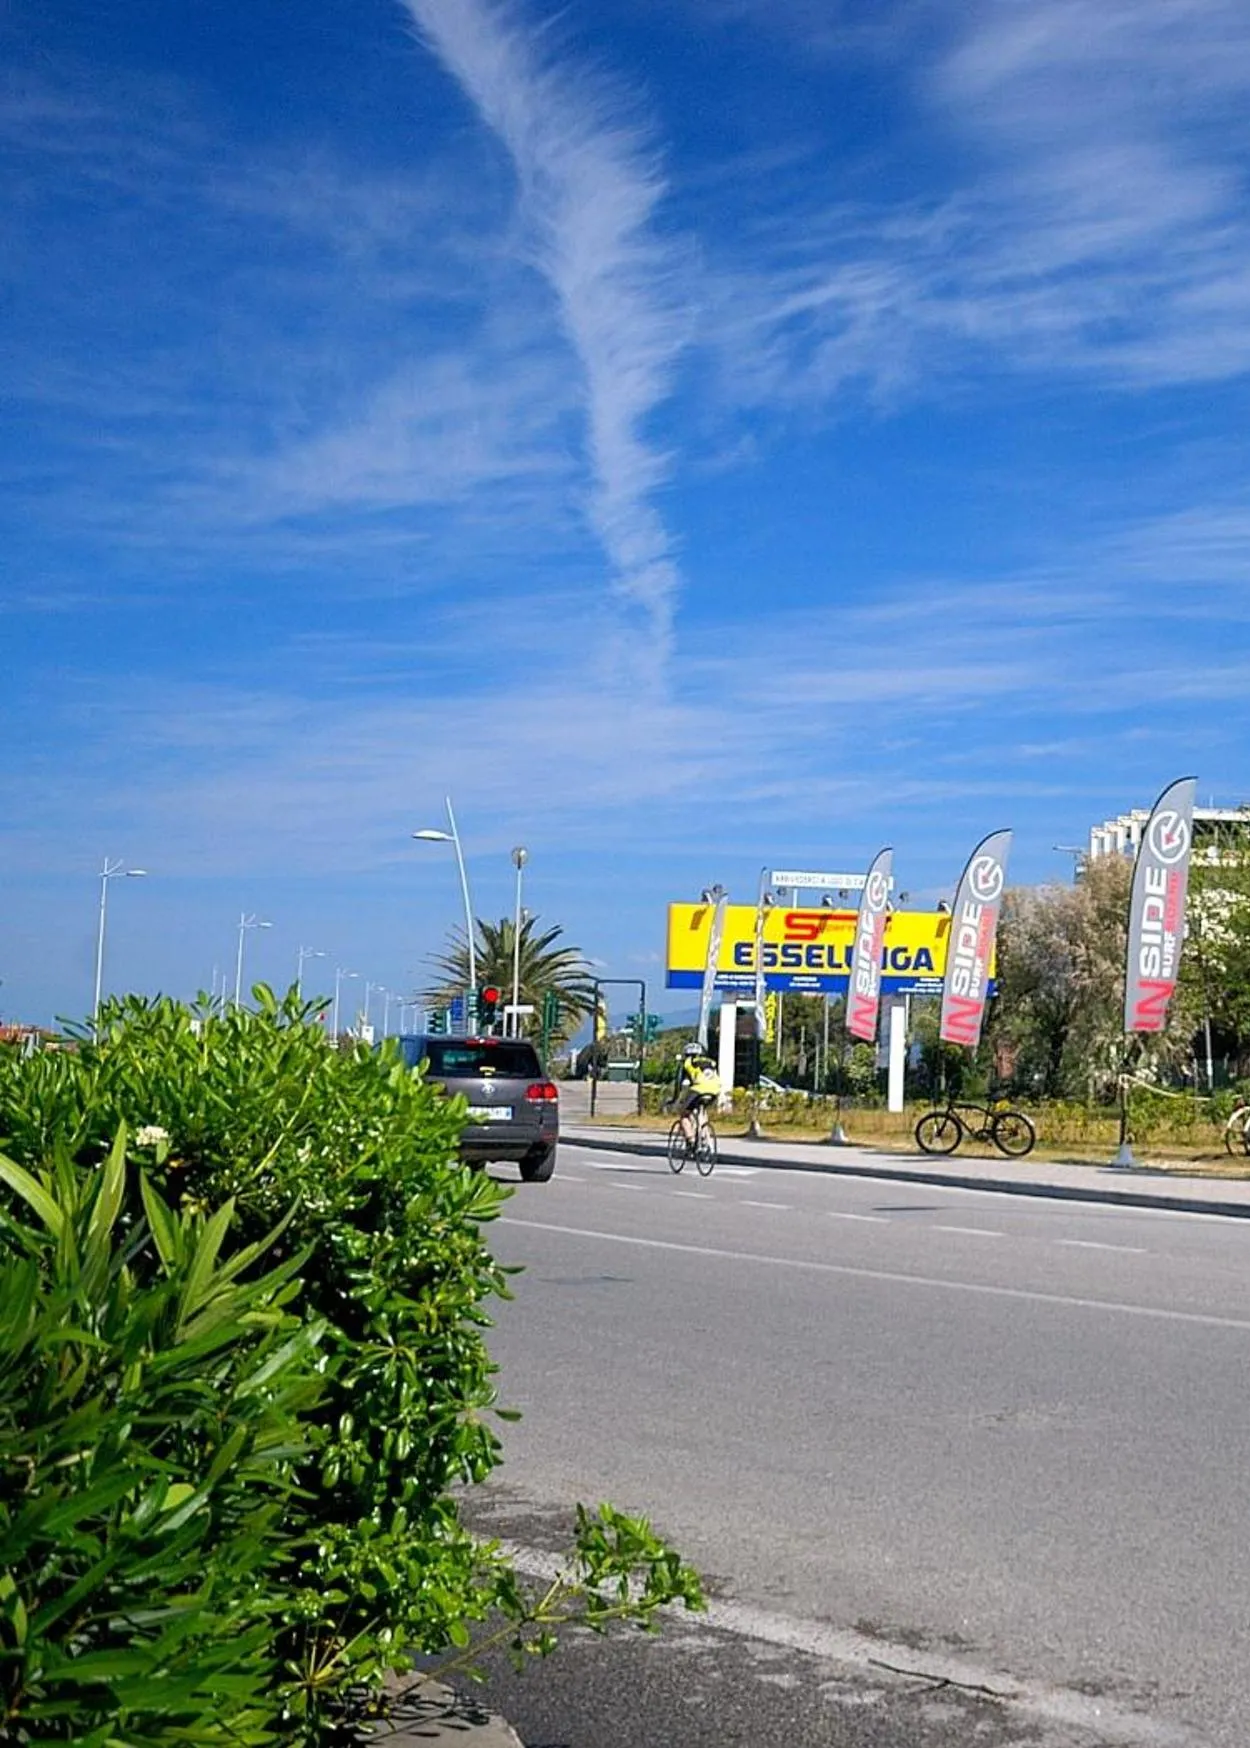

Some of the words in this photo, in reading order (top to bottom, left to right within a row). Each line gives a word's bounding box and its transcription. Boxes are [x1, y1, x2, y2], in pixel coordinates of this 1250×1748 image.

[734, 941, 934, 970] ESSELGA
[943, 902, 983, 1043] INSIDE
[1132, 866, 1174, 1032] INSIDE
